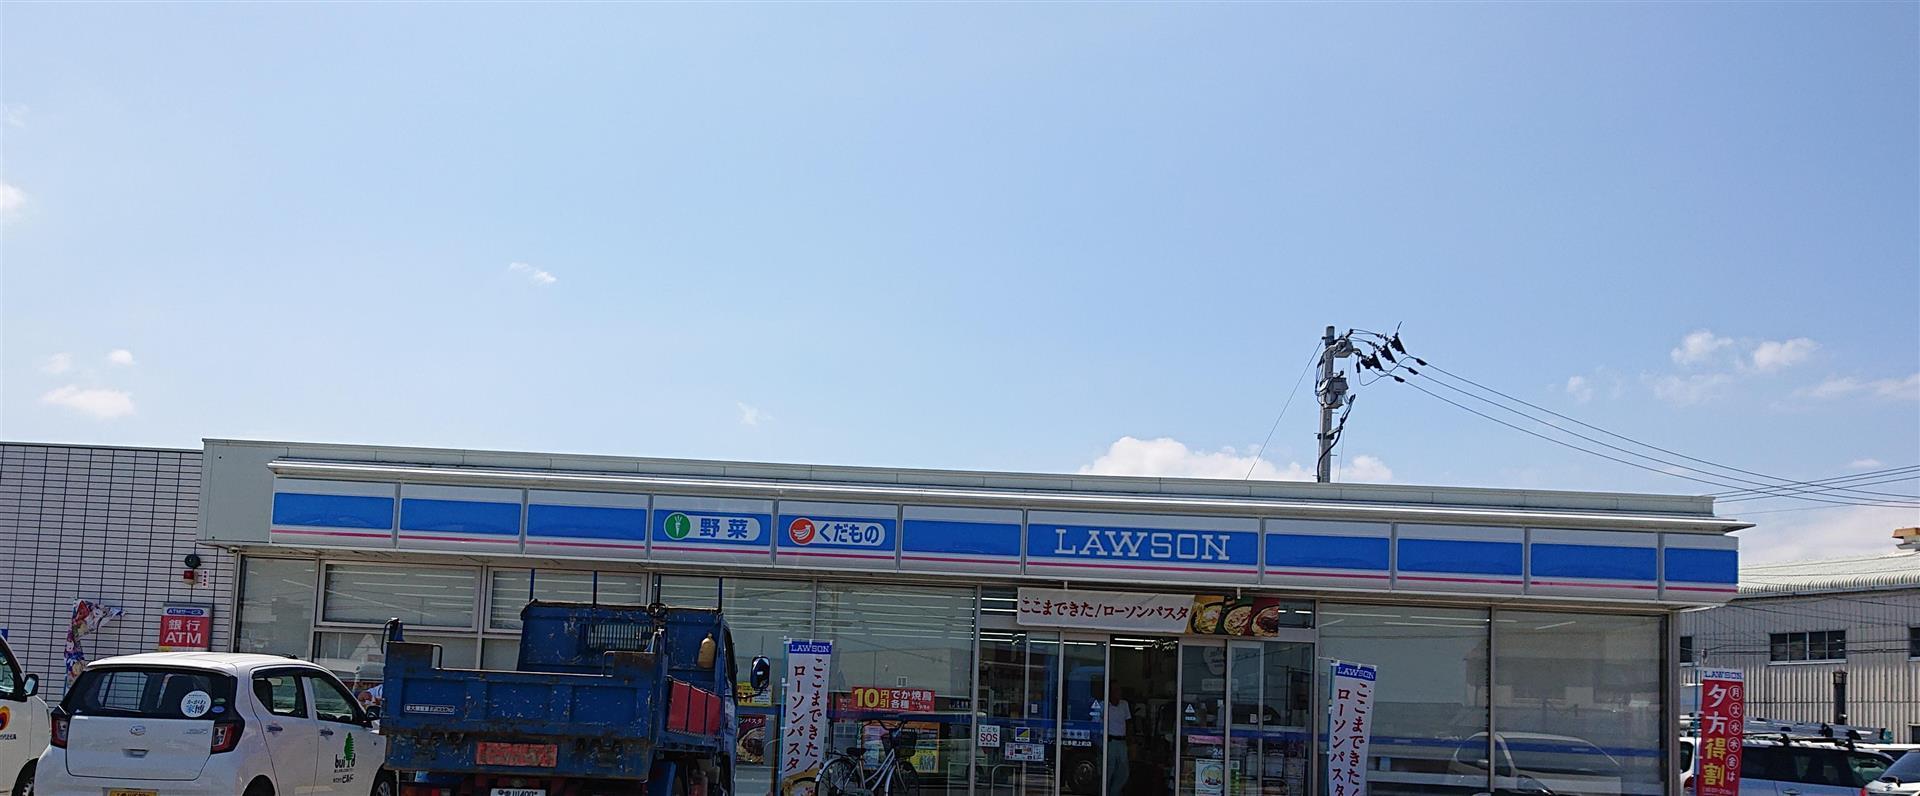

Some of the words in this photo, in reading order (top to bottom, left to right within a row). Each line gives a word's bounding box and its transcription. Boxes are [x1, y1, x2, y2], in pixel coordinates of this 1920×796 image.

[700, 518, 748, 539] 野菜
[819, 522, 879, 544] くだもの
[1054, 528, 1230, 561] LAWSON
[168, 618, 201, 631] 銀行
[165, 631, 202, 644] ATM
[791, 644, 830, 653] LAWSON
[1337, 666, 1375, 680] LAWSON
[1703, 670, 1742, 680] LAWSON
[785, 665, 806, 772] ローソンパスタ
[980, 733, 998, 743] SOS
[1704, 684, 1728, 787] 夕方得割
